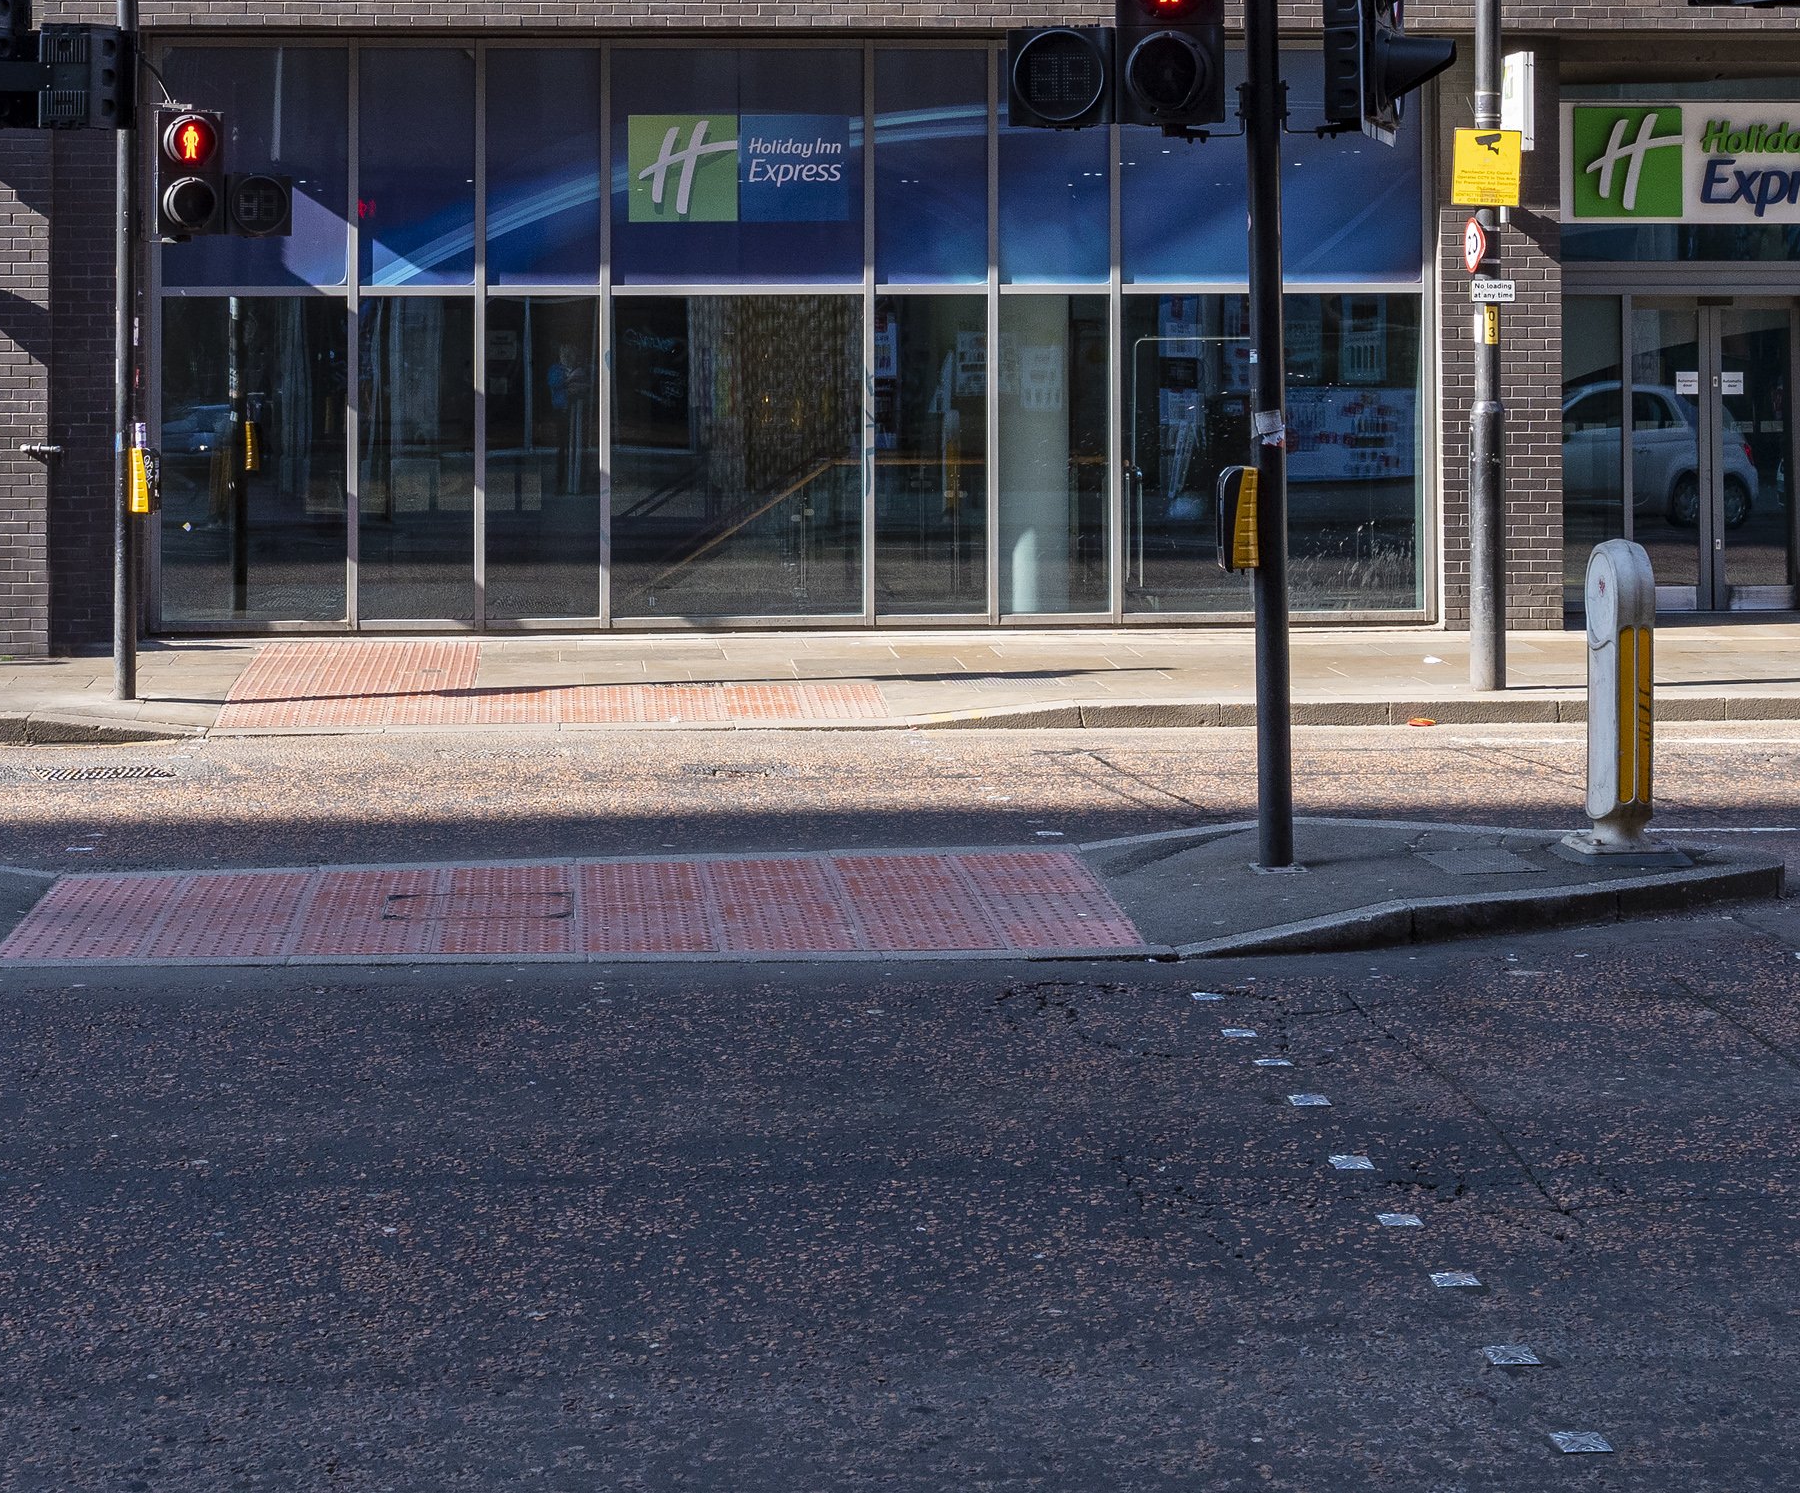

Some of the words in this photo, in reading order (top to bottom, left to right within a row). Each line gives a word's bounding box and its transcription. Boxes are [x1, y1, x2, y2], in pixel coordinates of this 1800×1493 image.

[748, 137, 813, 158] Holiday
[815, 137, 842, 154] Inn
[749, 159, 842, 187] Express
[1468, 233, 1478, 256] 20
[1487, 283, 1512, 292] loading
[1488, 311, 1495, 321] 0
[1488, 327, 1496, 337] 3
